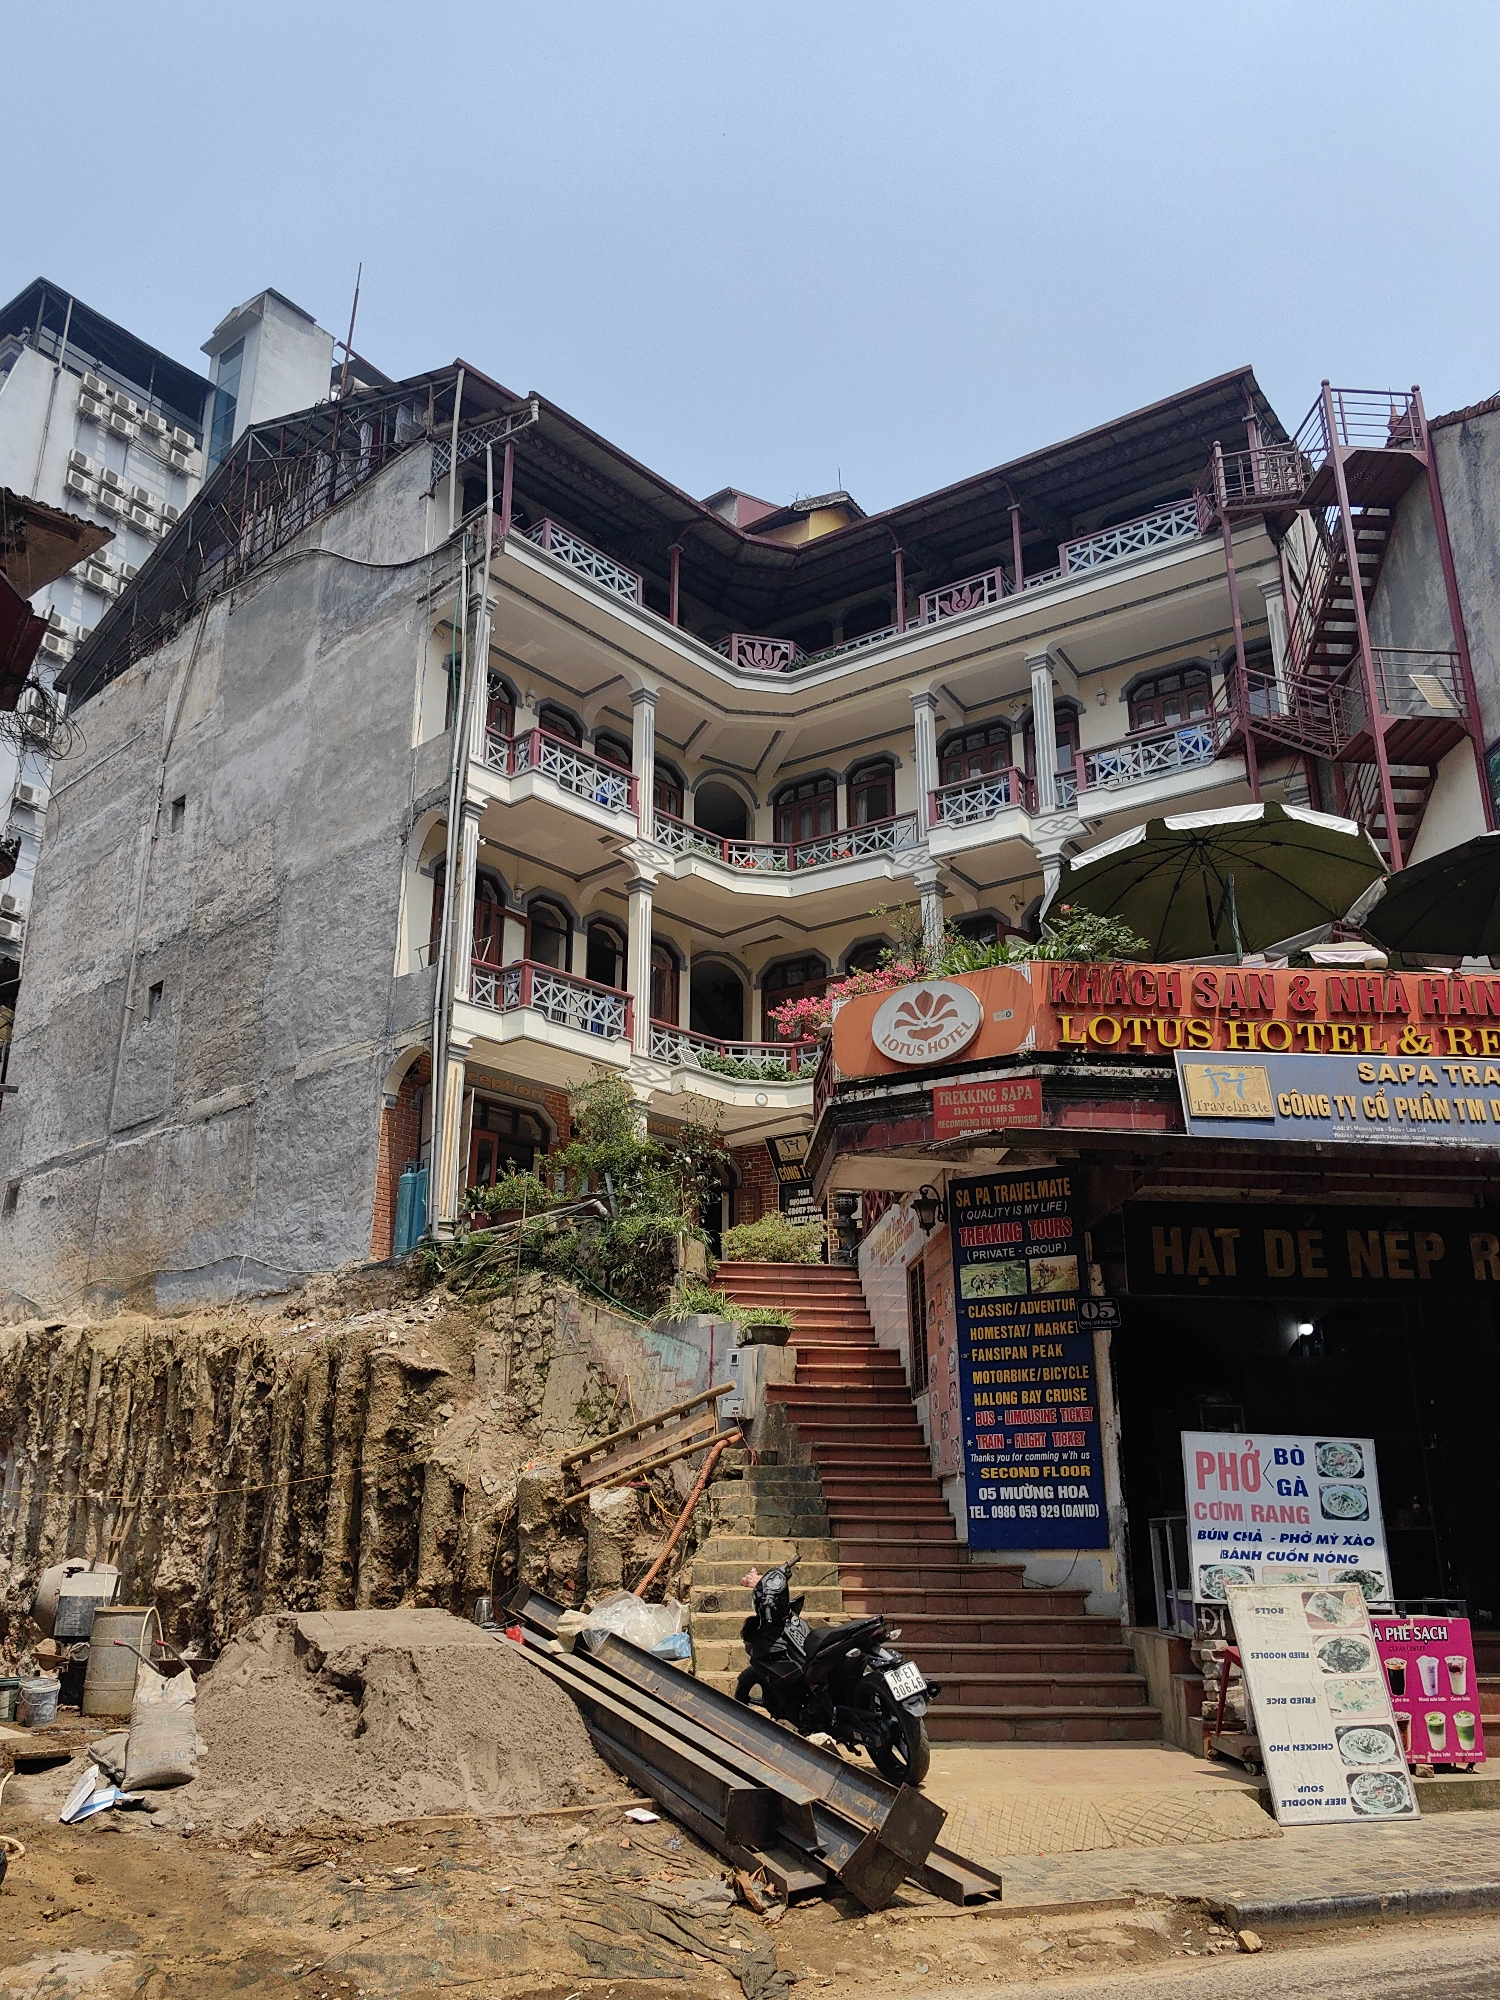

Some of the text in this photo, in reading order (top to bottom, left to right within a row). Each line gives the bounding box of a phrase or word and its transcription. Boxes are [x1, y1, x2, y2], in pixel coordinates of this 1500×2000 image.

[1050, 961, 1182, 1008] KHÁCH
[1193, 971, 1276, 1017] SẠN
[1290, 974, 1318, 1012] &
[1327, 969, 1411, 1014] NHÀ
[881, 1020, 973, 1057] LOTUS HOTEL
[1057, 1014, 1500, 1057] LOTUS HOTEL & RE
[1357, 1061, 1500, 1085] SAPA TRA
[938, 1085, 1034, 1107] TREKKING SAPA
[1277, 1088, 1332, 1117] CÔNG
[1333, 1095, 1357, 1119] TY
[1362, 1087, 1390, 1119] CỔ
[1394, 1089, 1451, 1121] PHẦN
[1453, 1098, 1487, 1121] TM
[953, 1103, 1016, 1116] DAY TOURS
[937, 1114, 1038, 1129] RECOMMEND ON TRIP ADVISOR
[778, 1164, 802, 1181] CÔNG
[955, 1177, 1072, 1208] SA PA TRAVELMATE
[1012, 1205, 1022, 1216] IS
[1024, 1204, 1039, 1215] MY
[959, 1216, 1073, 1247] TREKKING TOURS
[1151, 1226, 1241, 1286] HẠT
[1346, 1214, 1446, 1280] NẾP
[1081, 1301, 1116, 1320] 05
[970, 1323, 1031, 1341] HOMESTAY/
[972, 1343, 1064, 1362] FANSIPAN PEAK
[974, 1387, 1088, 1406] HALONG BAY CRUISE
[975, 1410, 995, 1427] BUS
[1004, 1408, 1057, 1425] LIMOUSINE
[1059, 1406, 1093, 1423] TICKET
[976, 1433, 1005, 1450] TRAIN
[1014, 1432, 1047, 1449] FLIGHT
[1052, 1430, 1086, 1447] TICKET
[970, 1453, 995, 1463] Thanks
[996, 1454, 1010, 1464] you
[1011, 1452, 1023, 1462] for
[1025, 1451, 1060, 1463] comming
[1273, 1444, 1305, 1466] BÒ
[980, 1465, 1091, 1479] SECOND FLOOR
[1195, 1439, 1262, 1493] PHỞ
[978, 1482, 1089, 1501] 05 MƯỜNG HOA
[1277, 1475, 1309, 1497] GÀ
[969, 1503, 1100, 1519] TEL. 0986 059 929 (DAVID)
[1194, 1501, 1311, 1525] CƠM RANG
[1197, 1528, 1229, 1541] BÚN
[1233, 1528, 1263, 1543] CHẢ
[1280, 1531, 1312, 1545] PHỞ
[1315, 1534, 1339, 1545] MỲ
[1342, 1534, 1375, 1547] XÀO
[1220, 1547, 1360, 1565] BÁNH CUỐN NÓNG
[1254, 1607, 1284, 1615] ROLLS
[1386, 1623, 1411, 1641] PHÊ
[1414, 1626, 1448, 1644] SẠCH
[1250, 1651, 1310, 1660] FRIED NOODLES
[893, 1677, 924, 1698] 306.46
[1266, 1697, 1316, 1705] FRIED RICE
[1269, 1743, 1334, 1752] CHICKEN PHO
[1297, 1785, 1325, 1793] SOUP
[1281, 1797, 1347, 1808] BEEF NOODLE
